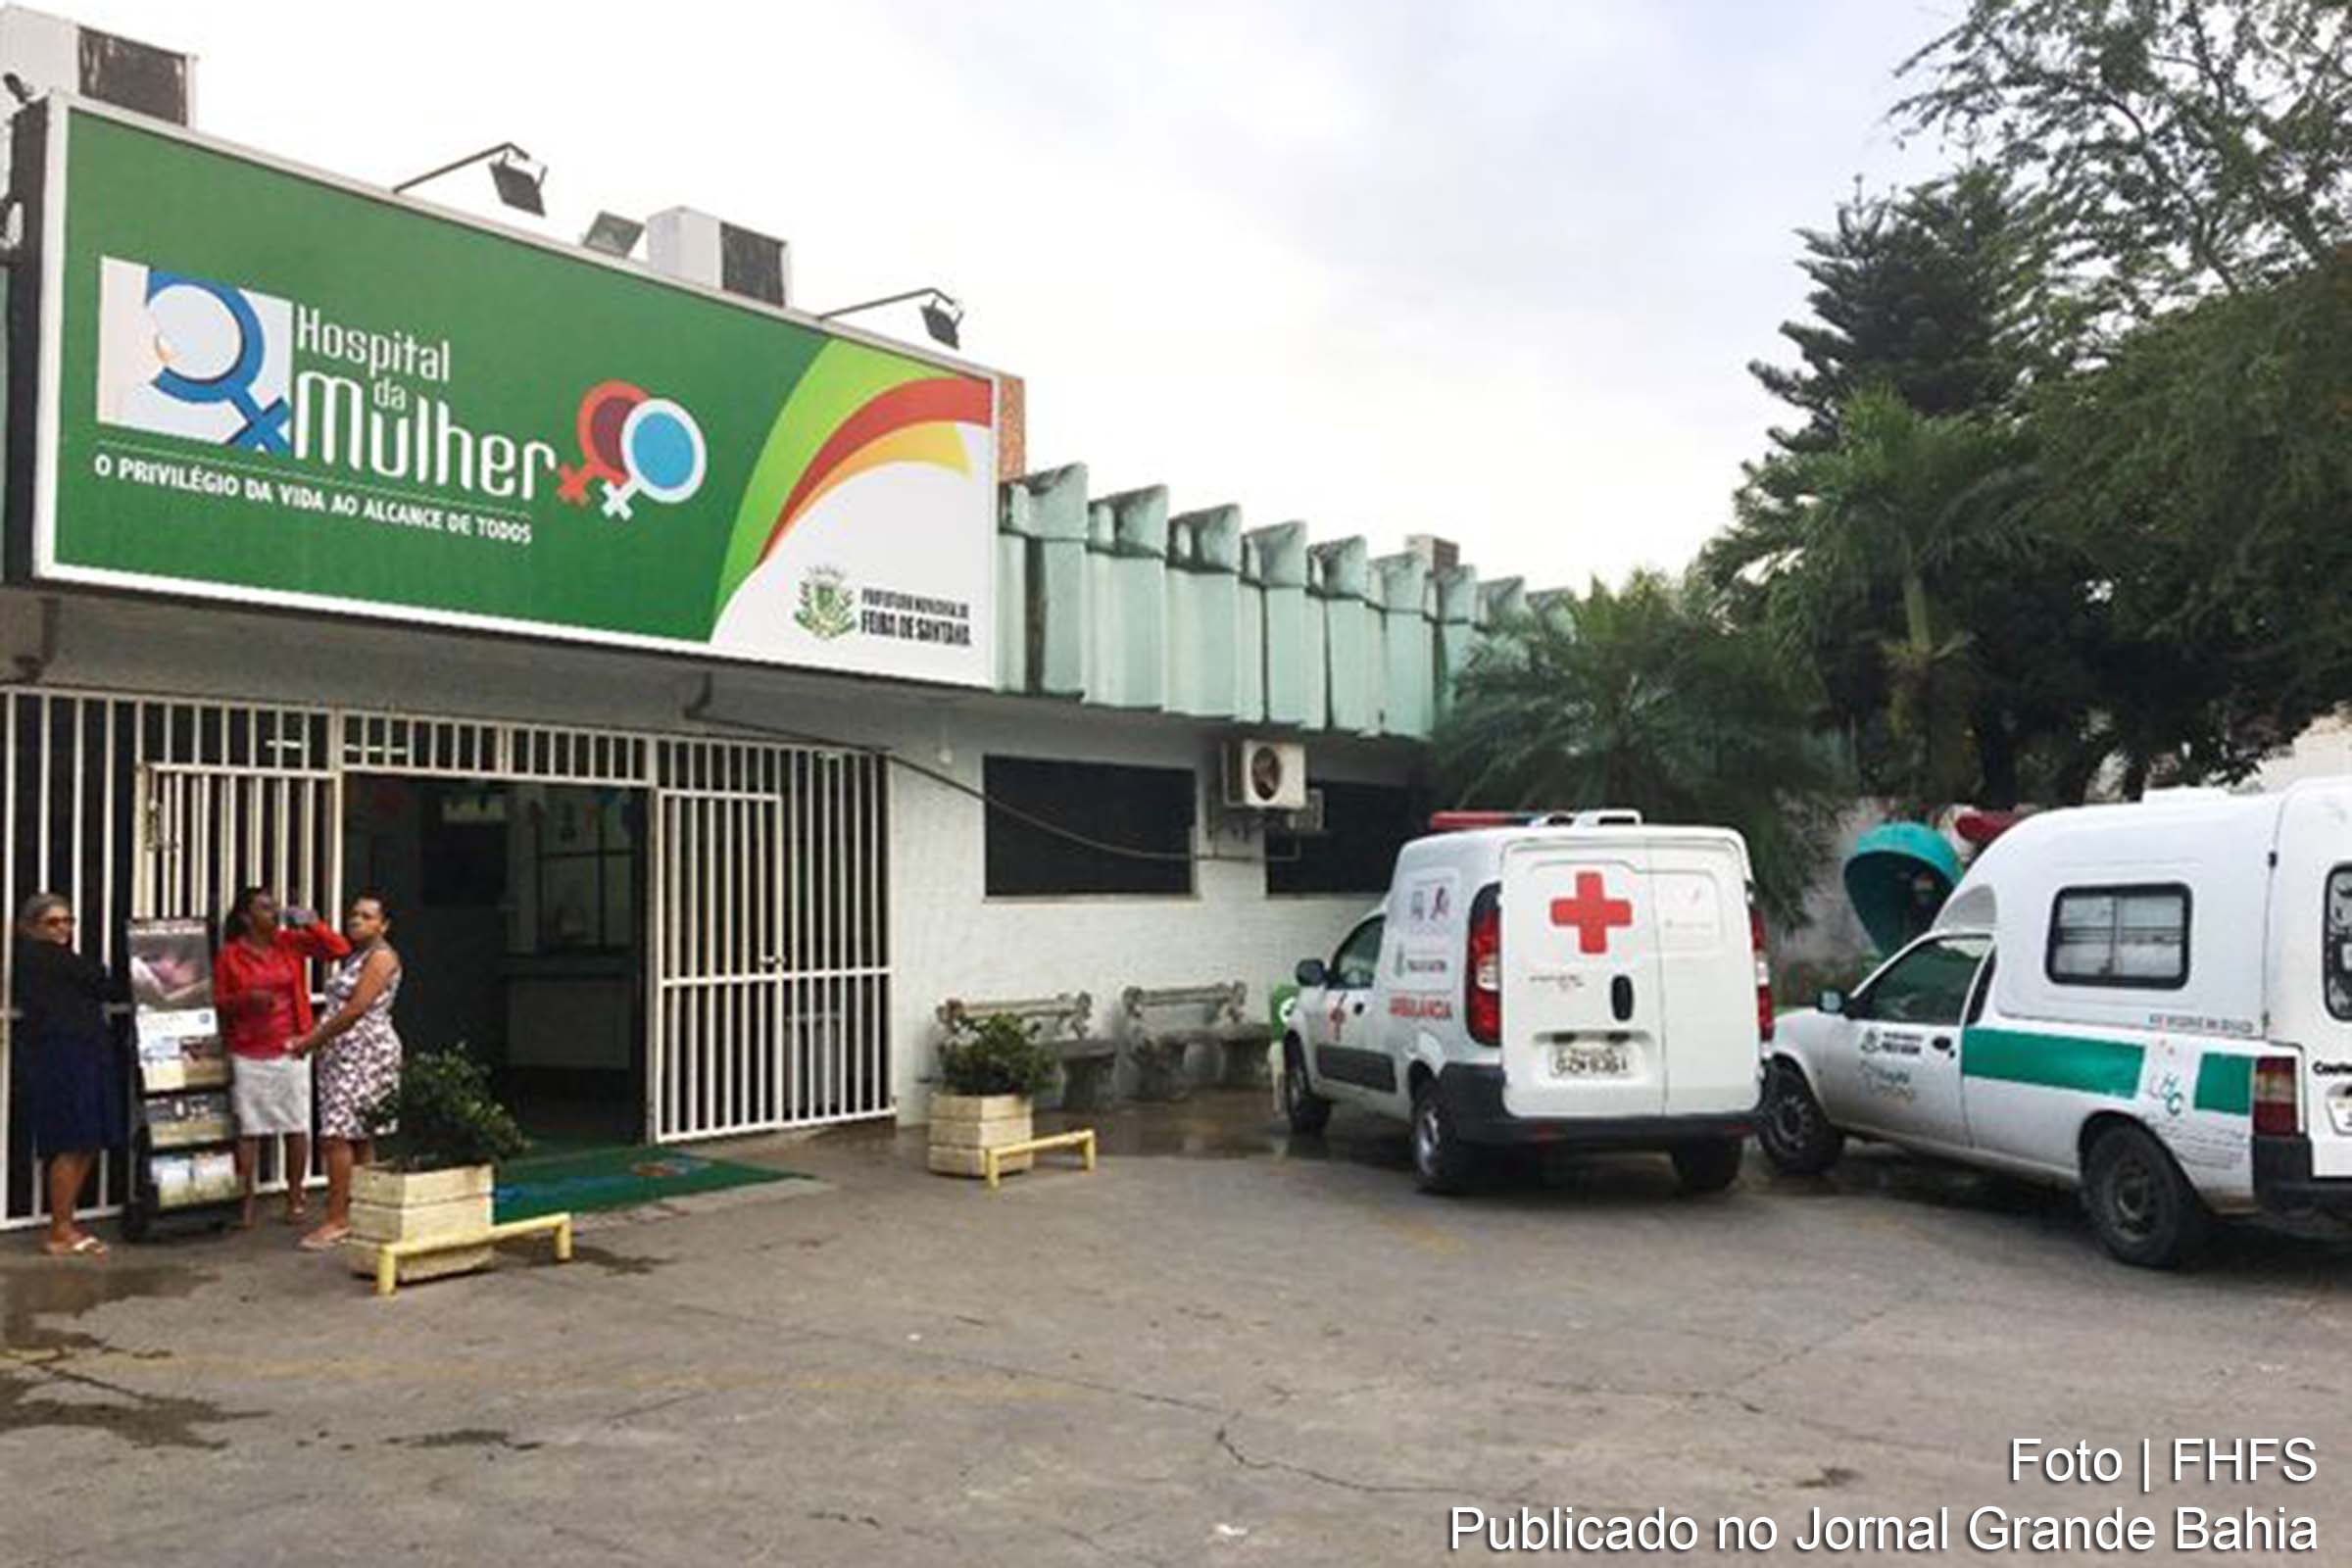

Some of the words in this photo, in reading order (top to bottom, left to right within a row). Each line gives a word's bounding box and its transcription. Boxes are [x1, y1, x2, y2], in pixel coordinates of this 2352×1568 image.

[297, 303, 450, 382] Hospital
[296, 369, 556, 501] Mulher
[372, 376, 407, 411] da
[95, 455, 112, 476] O
[118, 458, 239, 496] PRIVILÉGIO
[245, 480, 273, 503] DA
[279, 484, 326, 513] VIDA
[331, 493, 359, 516] AO
[364, 498, 441, 530] ALCANCE
[447, 513, 471, 535] DE
[476, 516, 532, 545] TODOS
